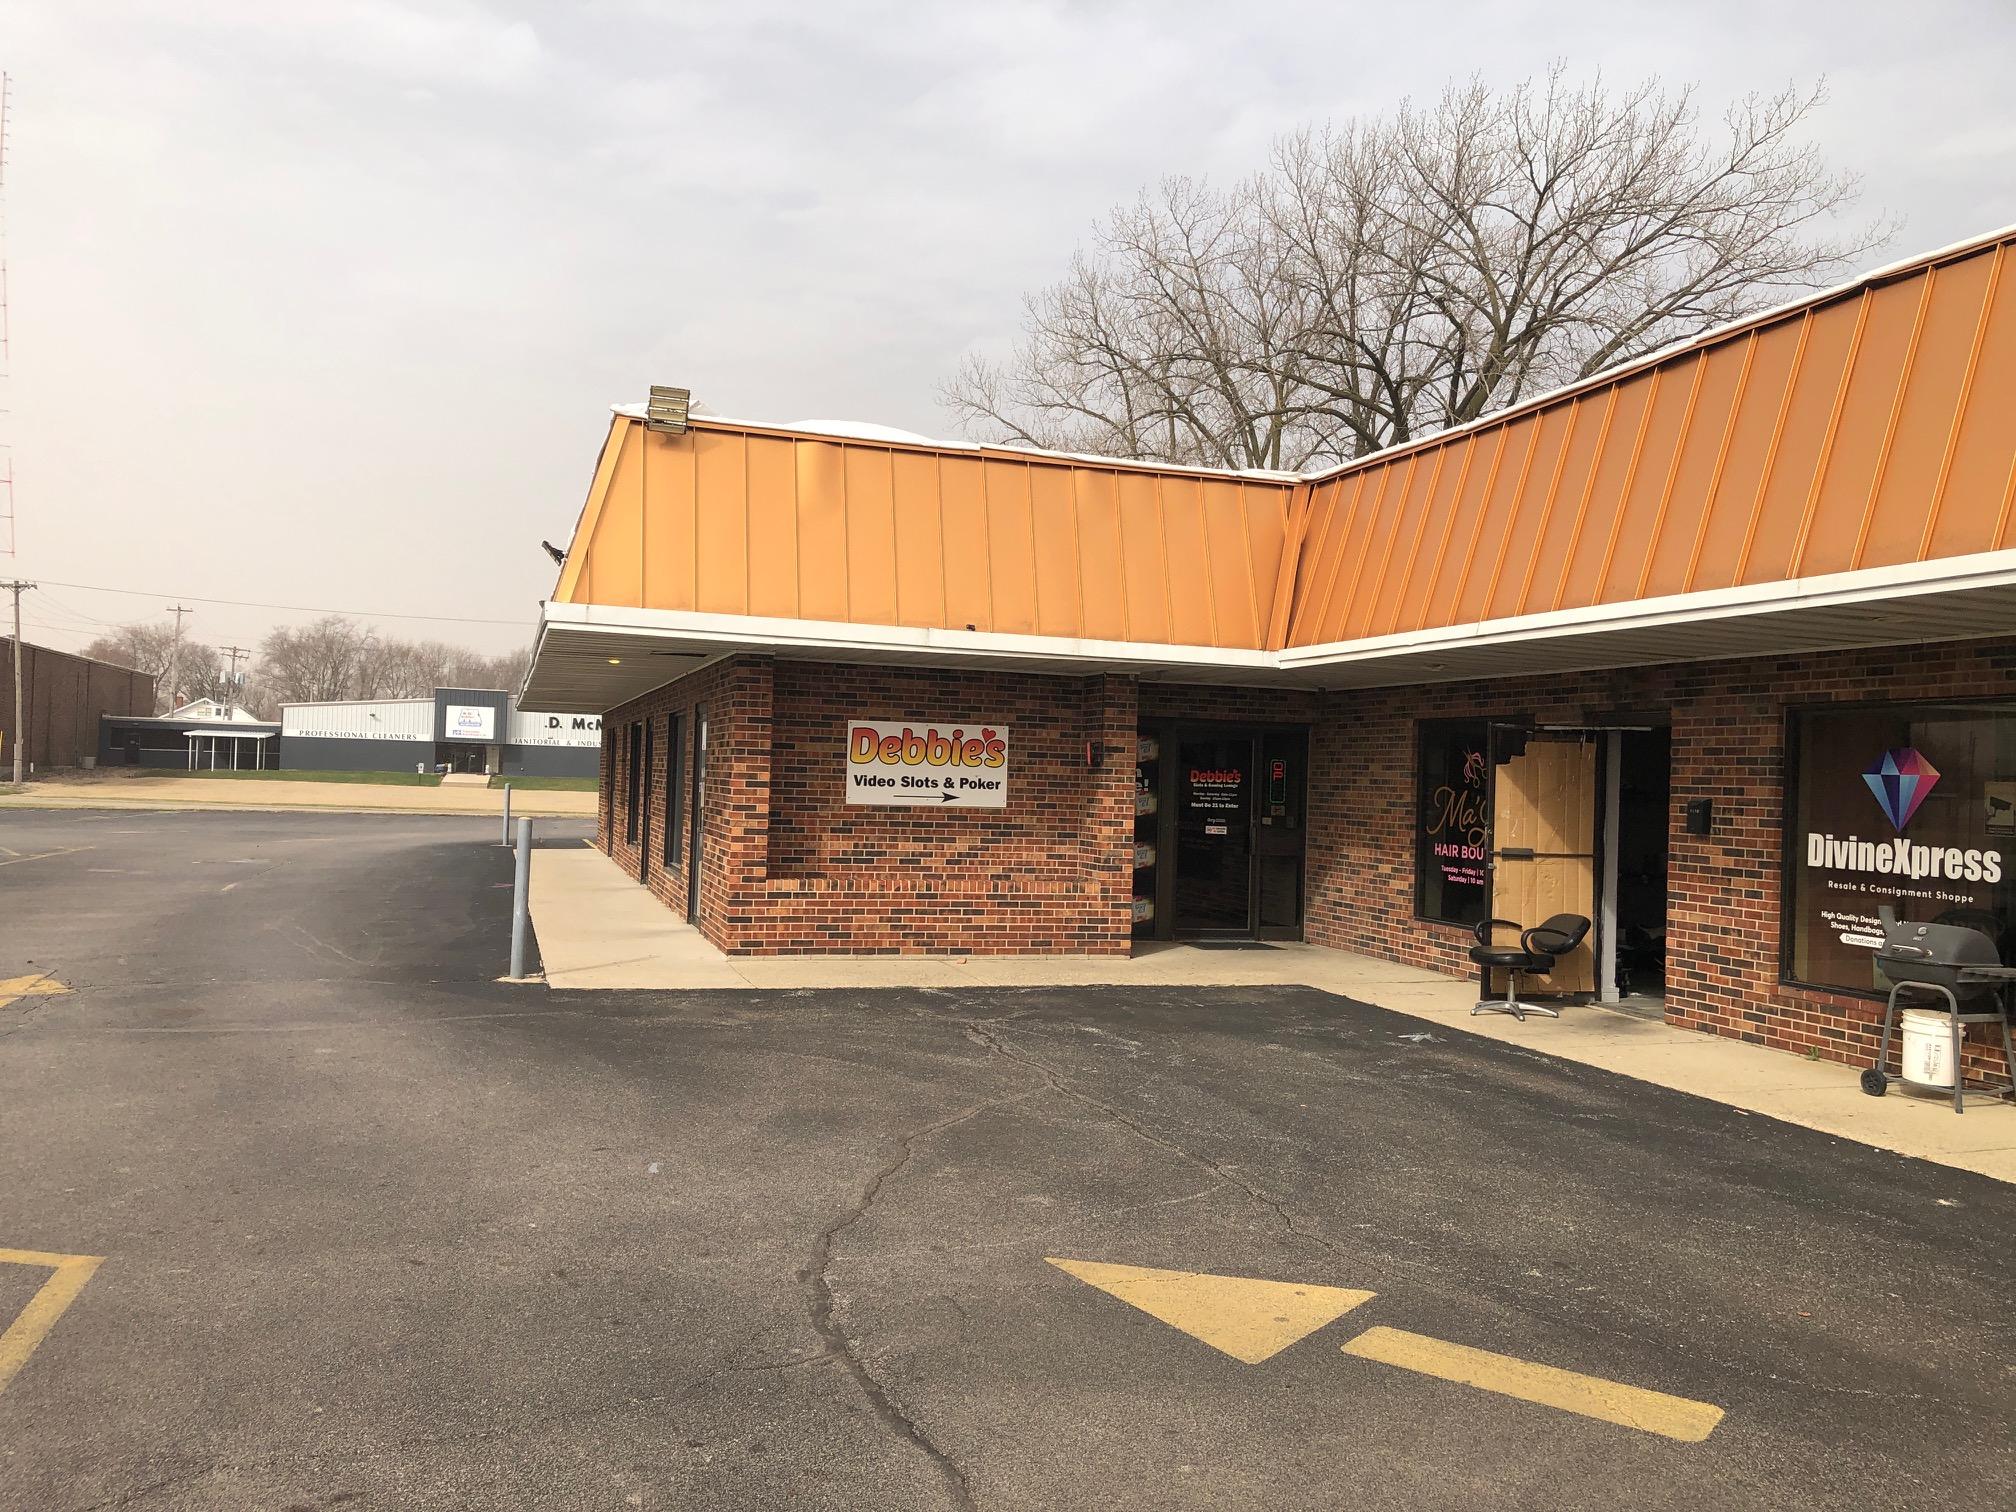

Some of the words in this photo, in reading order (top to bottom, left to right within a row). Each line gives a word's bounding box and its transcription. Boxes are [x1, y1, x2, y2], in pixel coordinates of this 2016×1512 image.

[299, 730, 368, 739] PROFESSIONAL
[514, 738, 560, 746] JANITORIAL
[850, 727, 1005, 768] Debbie's
[853, 775, 895, 787] Video
[901, 776, 939, 788] Slots
[943, 777, 955, 789] &
[960, 778, 1001, 790] Poker
[1190, 769, 1241, 783] Debbie's
[1434, 842, 1459, 858] HAIR
[1461, 845, 1484, 860] BOU
[1807, 832, 2001, 884] DivineXpress
[1441, 864, 1458, 874] Tuesday
[1461, 867, 1476, 876] Friday
[1447, 874, 1467, 884] Saturday
[1828, 880, 1857, 891] Resale
[1860, 883, 1866, 892] &
[1870, 884, 1932, 899] Consignment
[1936, 891, 1974, 903] Shoppe
[1821, 911, 1836, 920] High
[1836, 912, 1859, 924] Quality
[1860, 915, 1882, 926] Design
[1830, 921, 1850, 931] Shoes,
[1851, 924, 1885, 936] Handbags,
[1845, 935, 1877, 945] Donations
